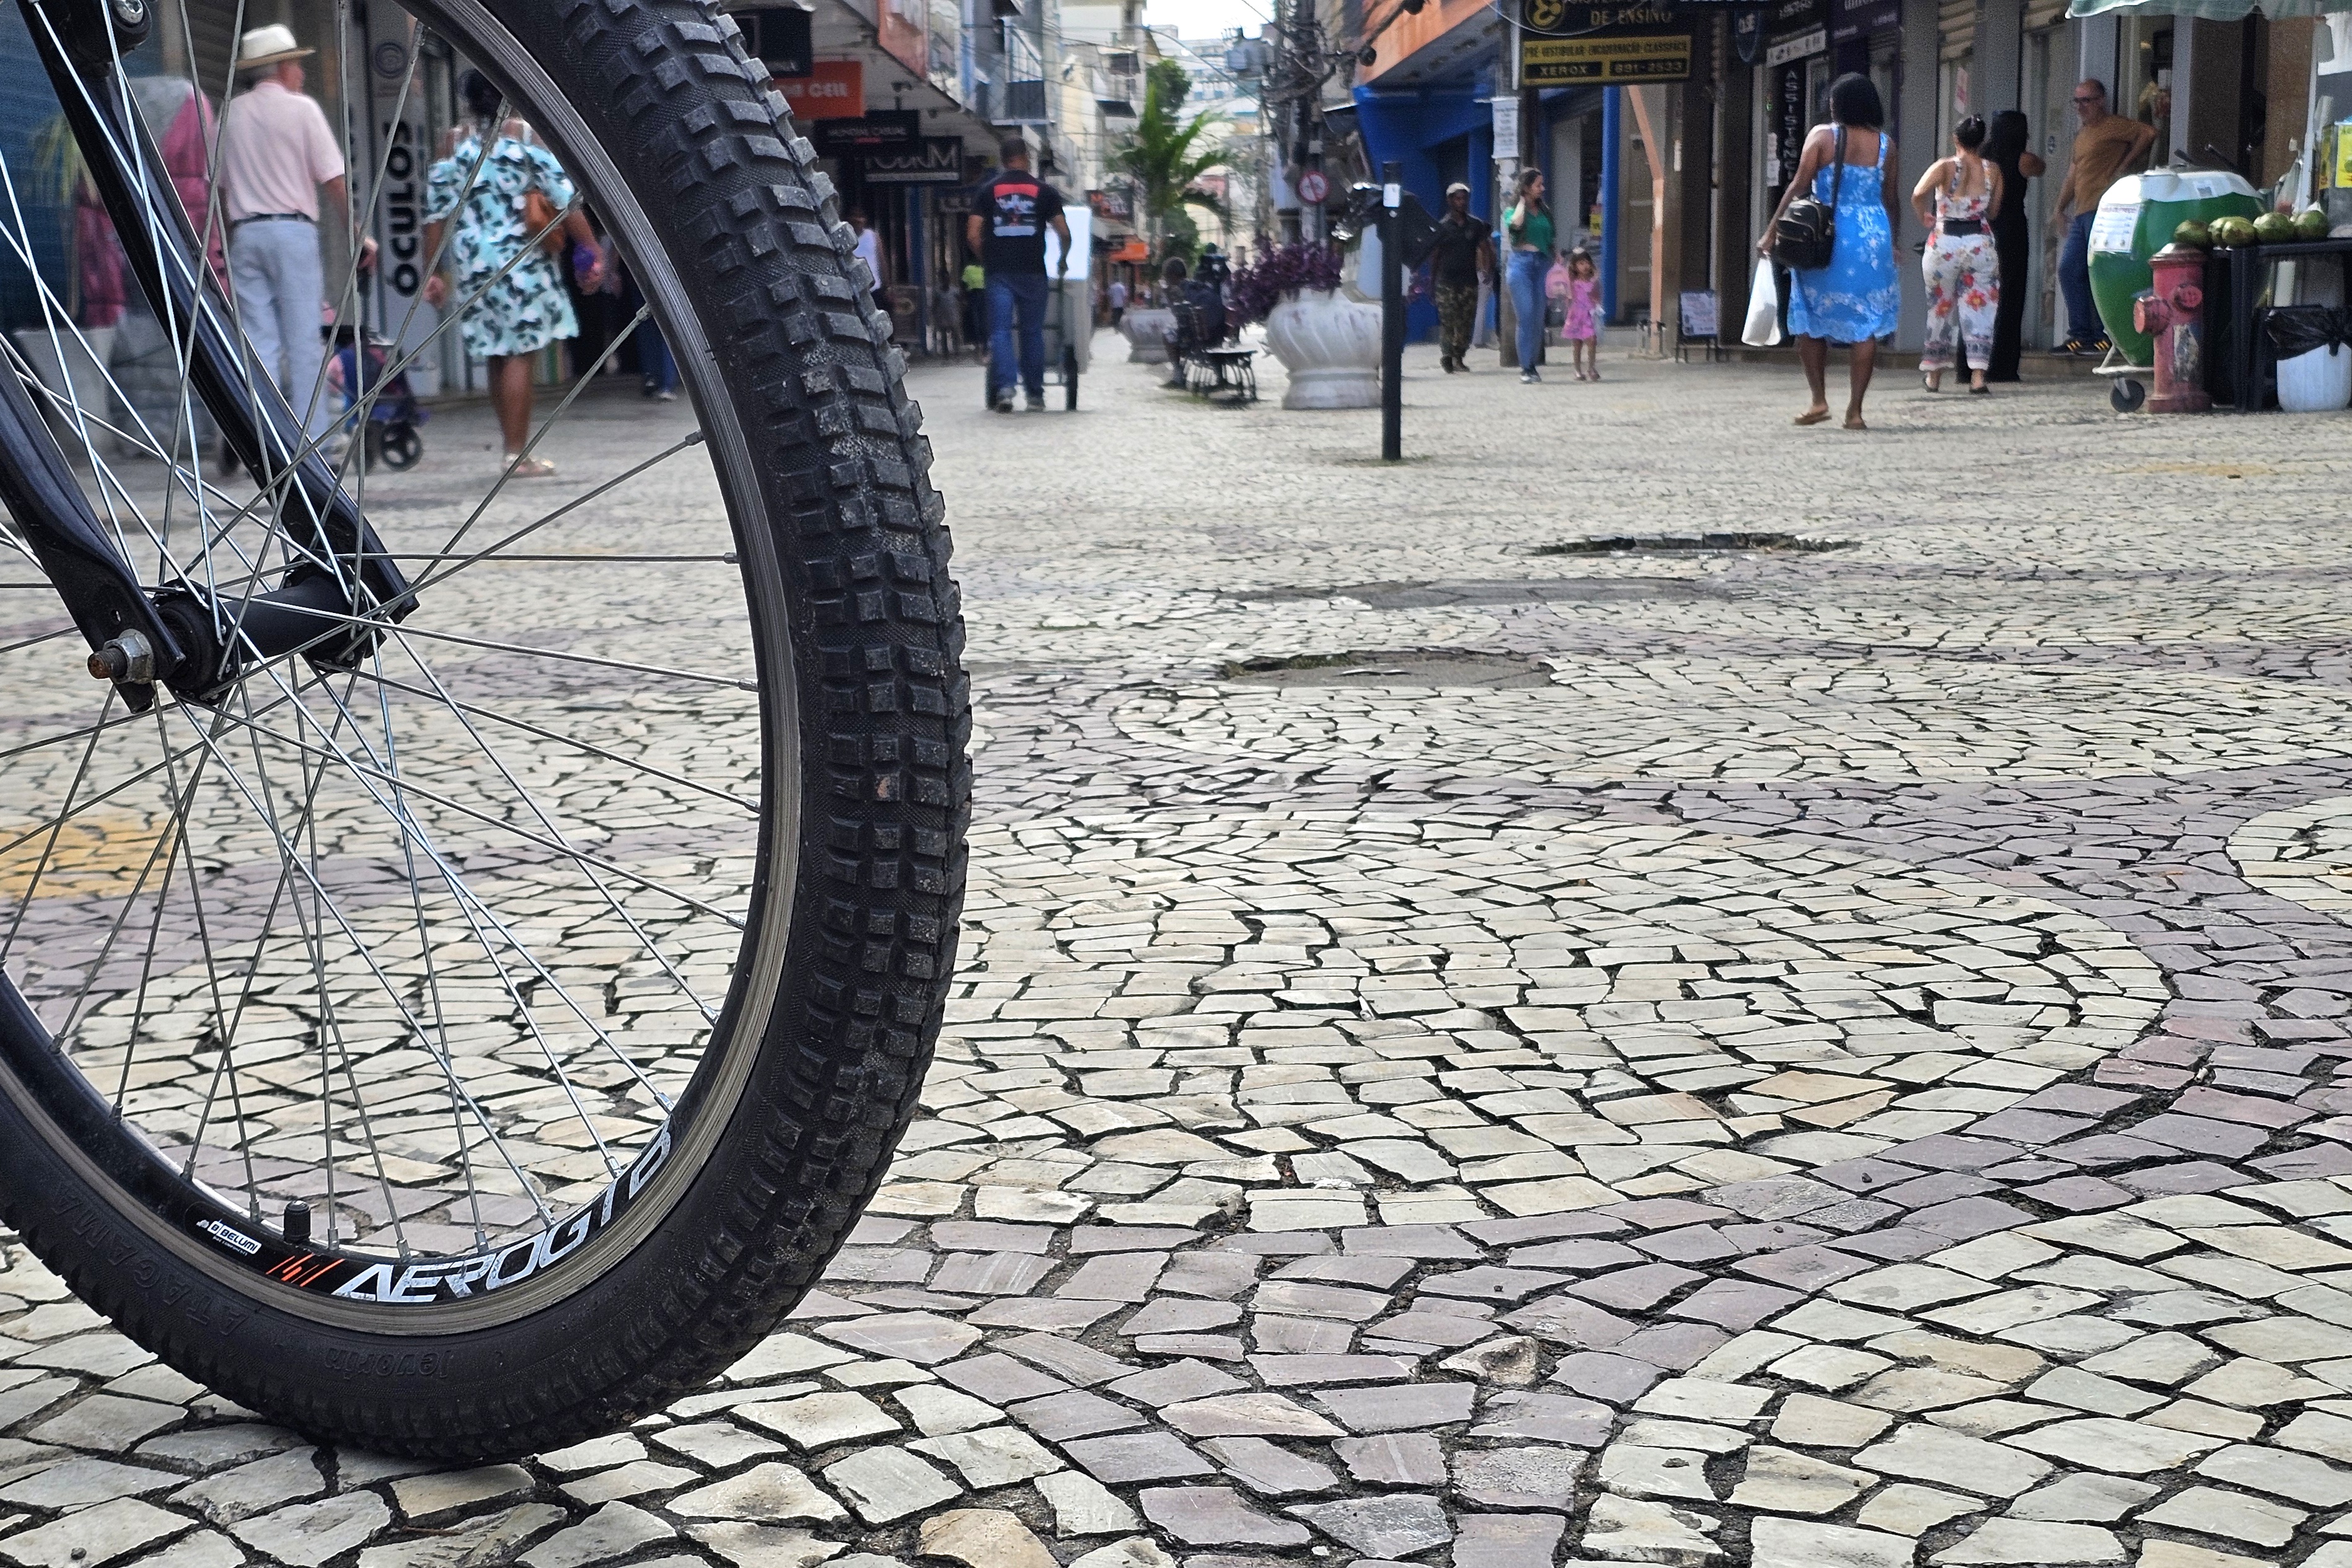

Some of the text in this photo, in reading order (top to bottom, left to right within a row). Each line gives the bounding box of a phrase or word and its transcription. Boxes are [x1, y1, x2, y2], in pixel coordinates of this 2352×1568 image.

[1591, 11, 1610, 25] DE
[1539, 65, 1588, 76] XEROX
[220, 1228, 259, 1253] BELUMI
